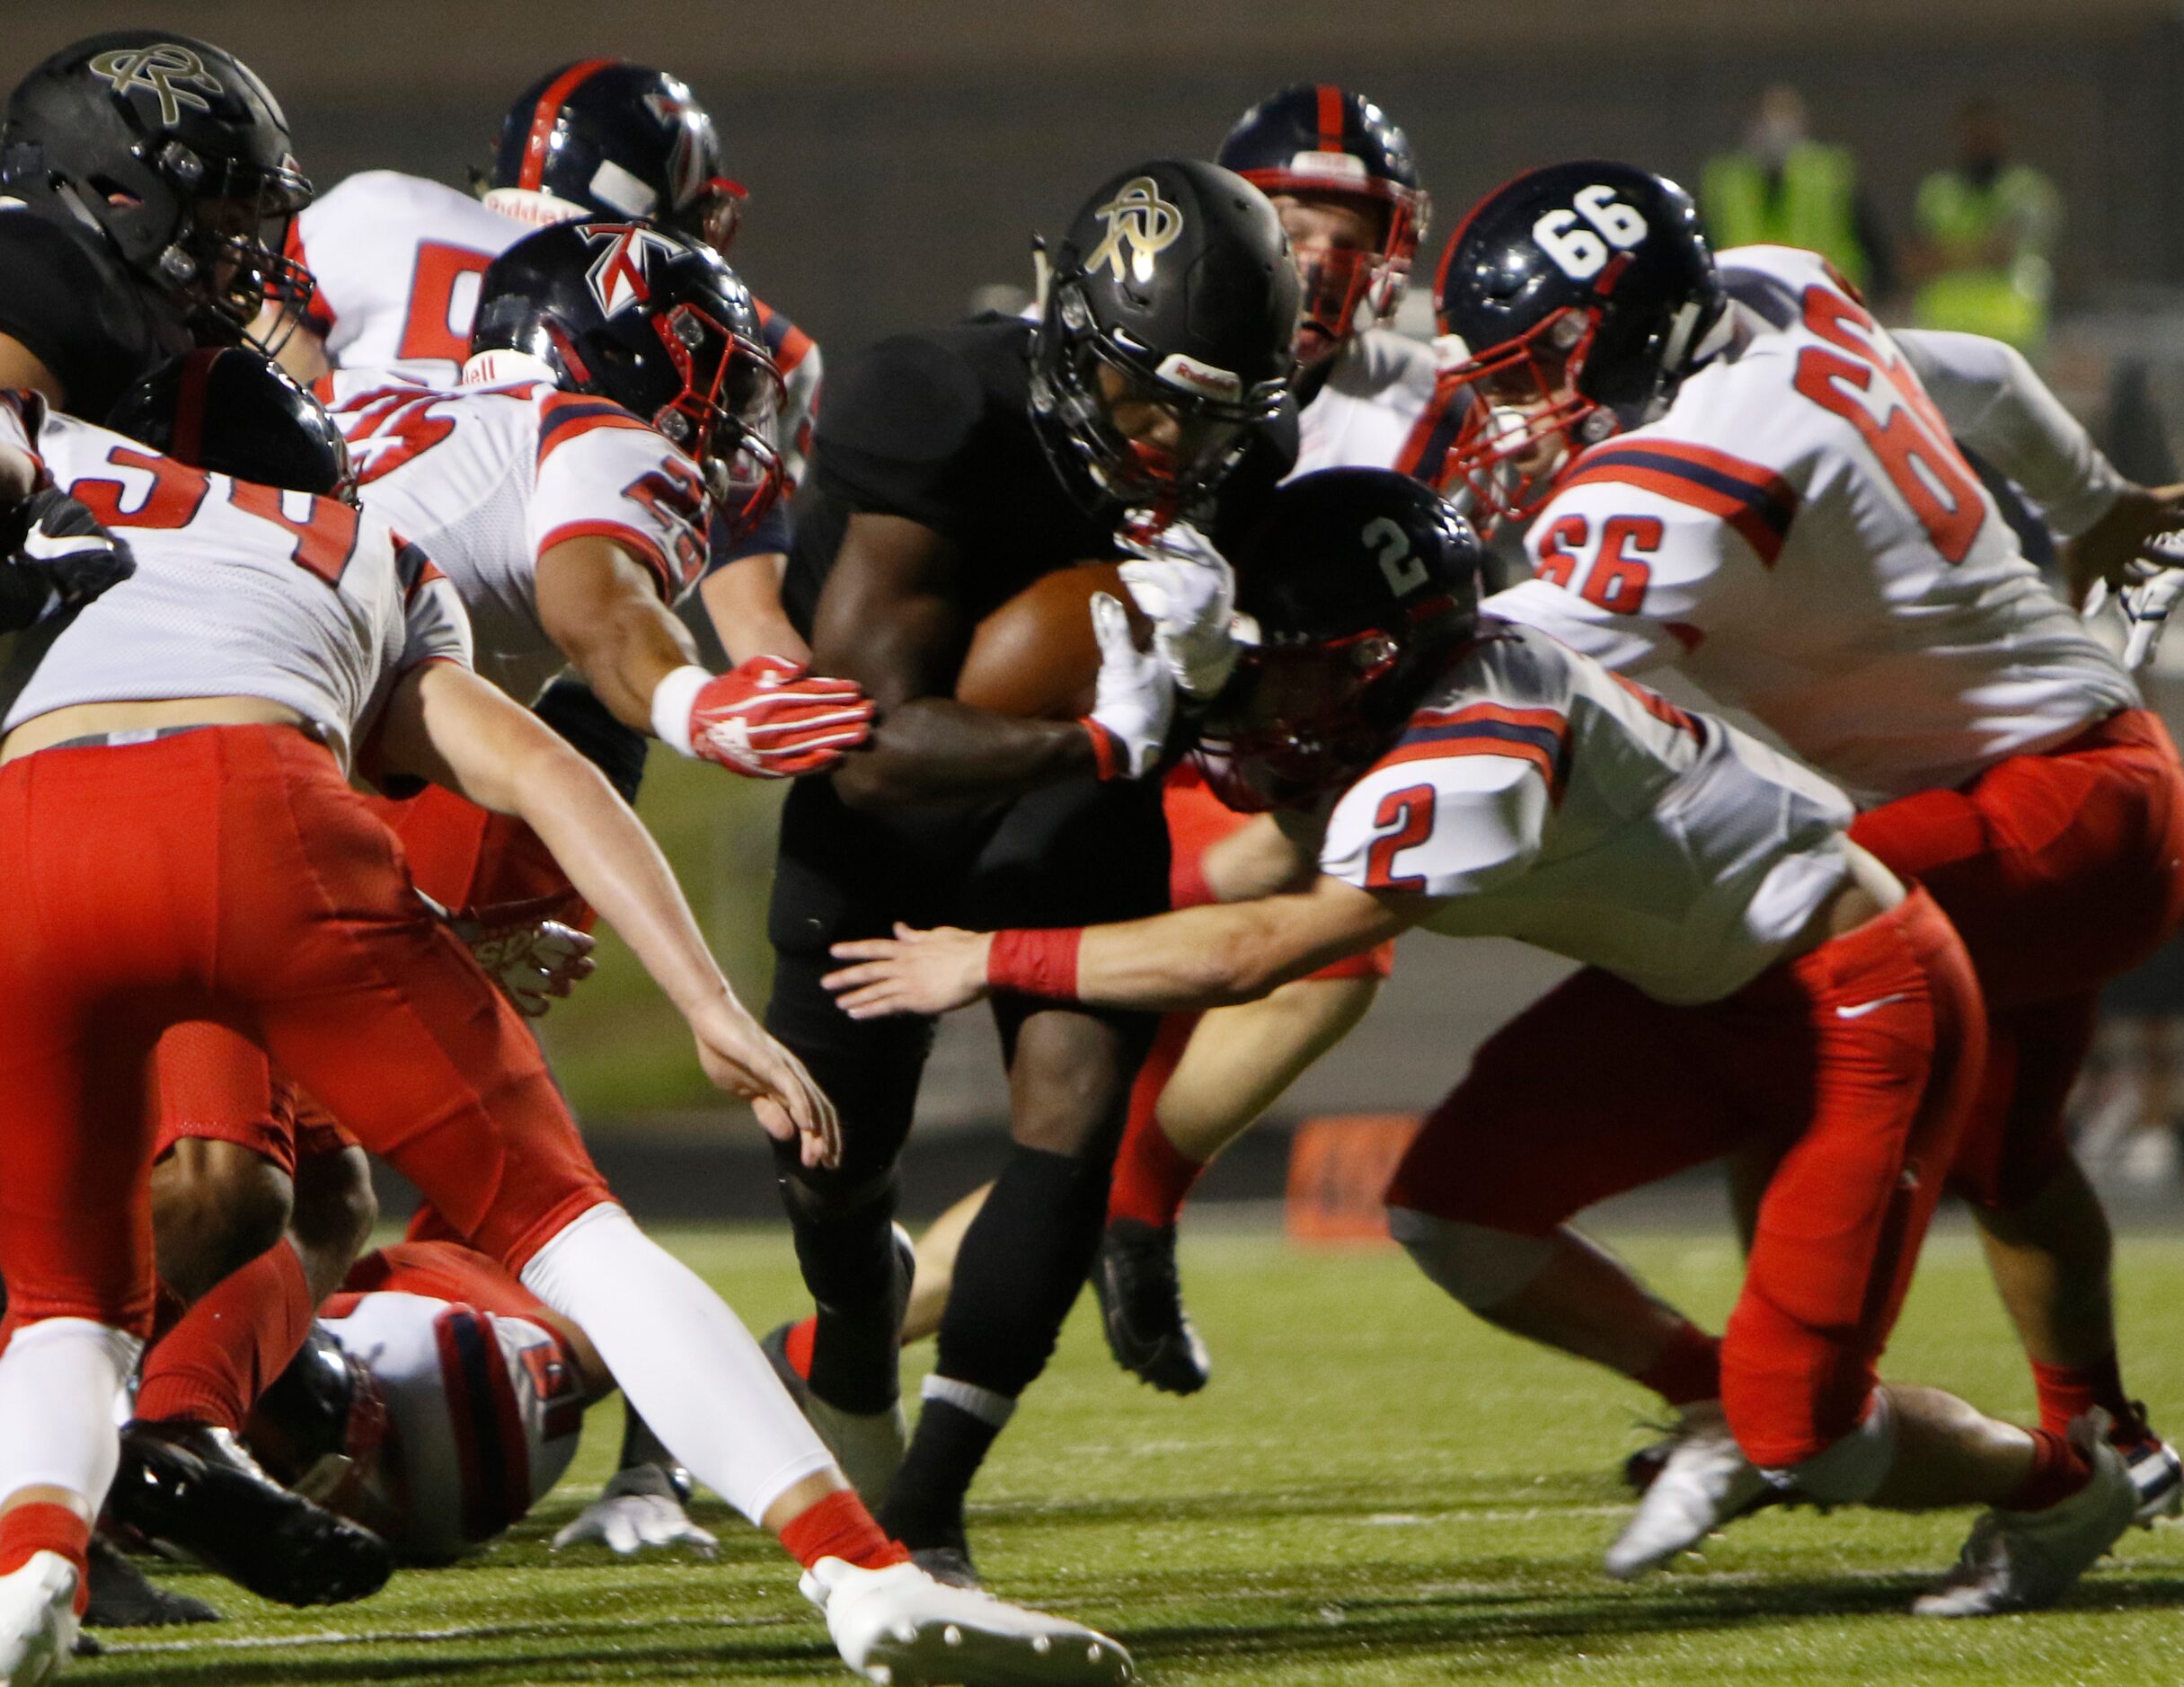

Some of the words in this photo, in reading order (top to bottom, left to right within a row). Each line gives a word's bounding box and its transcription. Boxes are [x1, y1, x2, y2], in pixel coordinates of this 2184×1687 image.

[1532, 184, 1648, 281] 66
[1792, 283, 1986, 565] 66
[1361, 517, 1429, 597] 2
[1533, 513, 1665, 615] 66
[1365, 782, 1436, 896] 2
